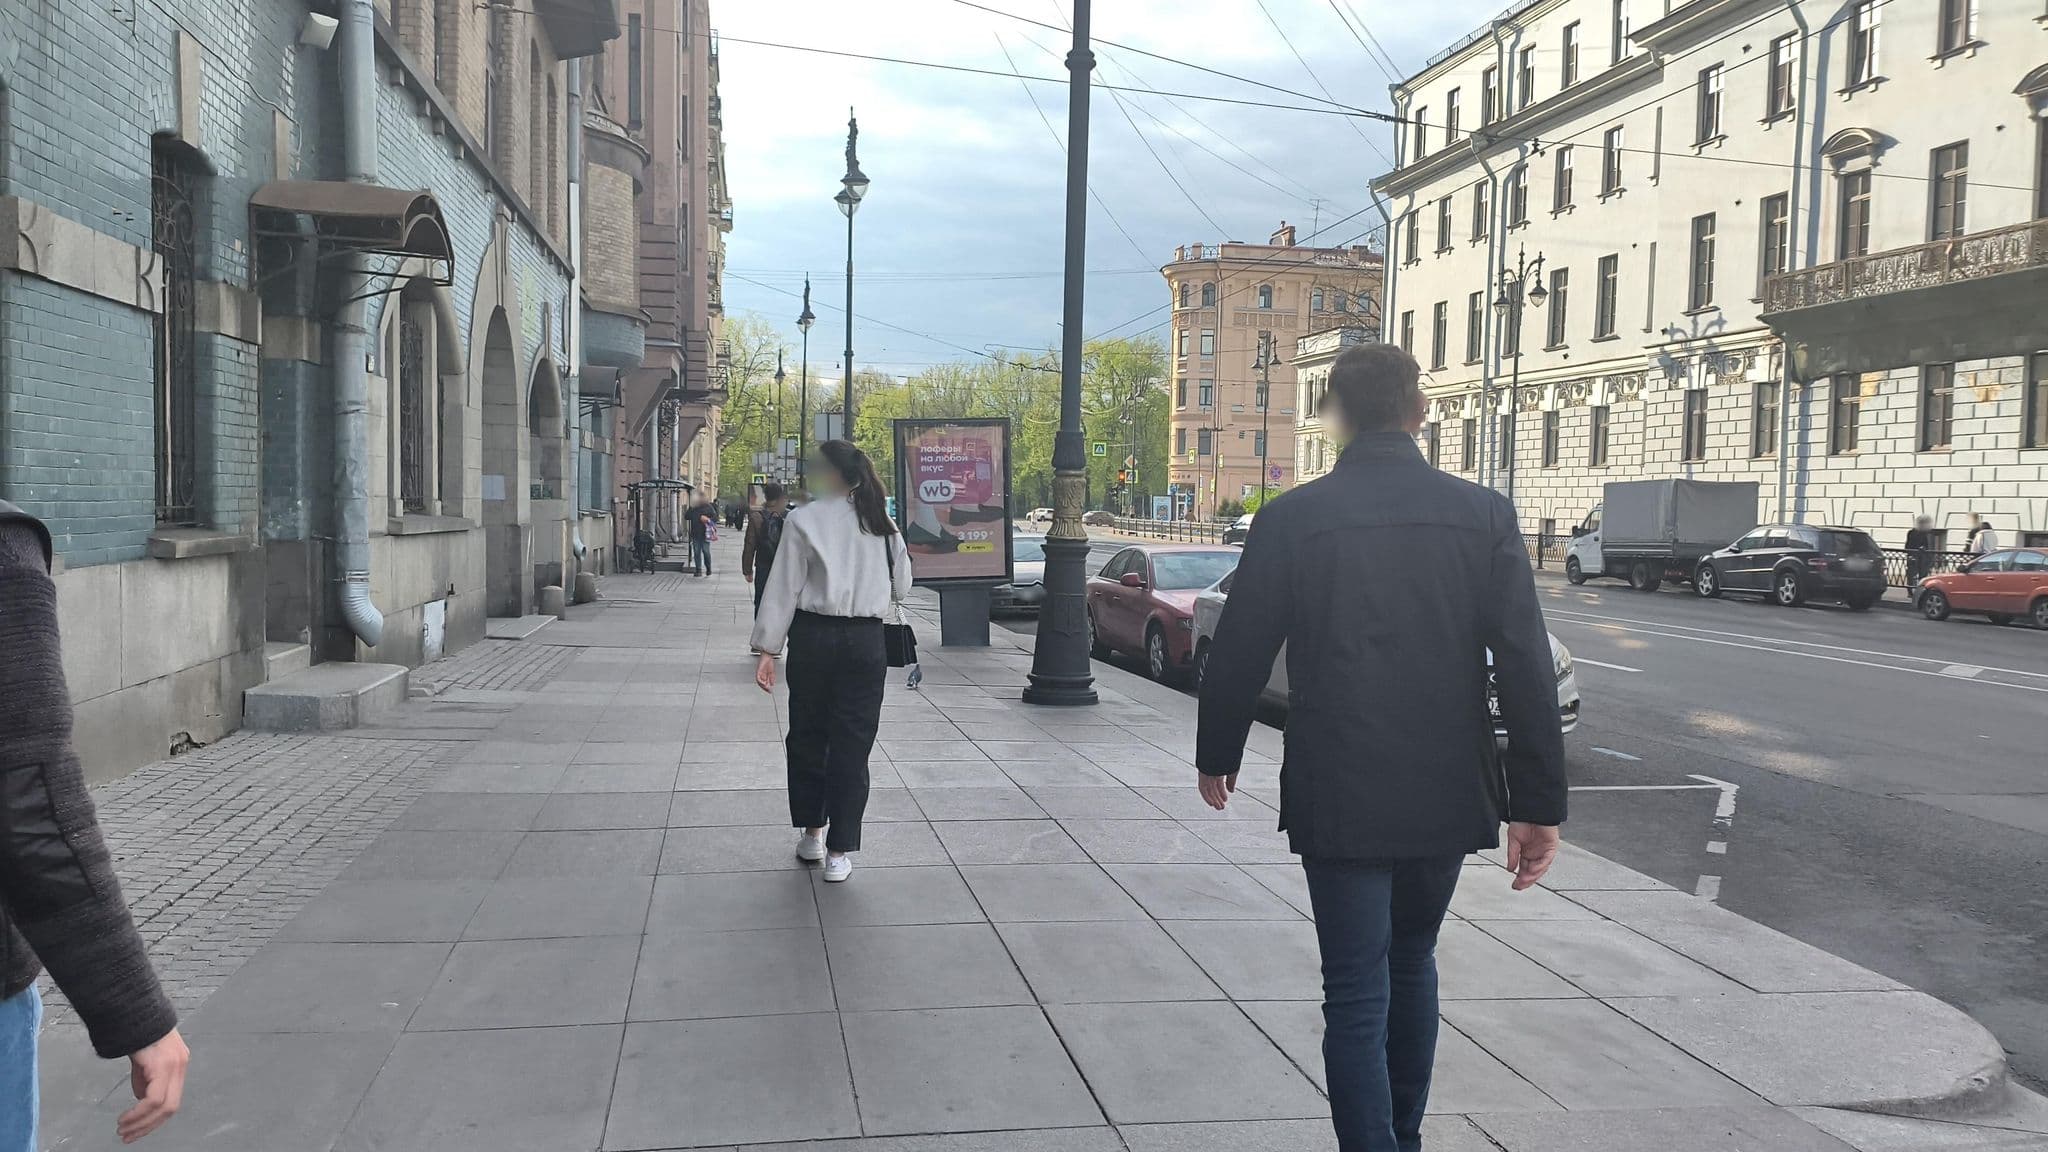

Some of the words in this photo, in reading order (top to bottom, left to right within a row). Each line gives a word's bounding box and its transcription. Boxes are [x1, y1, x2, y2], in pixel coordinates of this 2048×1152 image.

[920, 445, 961, 455] лоферы
[935, 453, 968, 462] любой
[921, 465, 944, 473] вкус
[923, 482, 951, 497] wb
